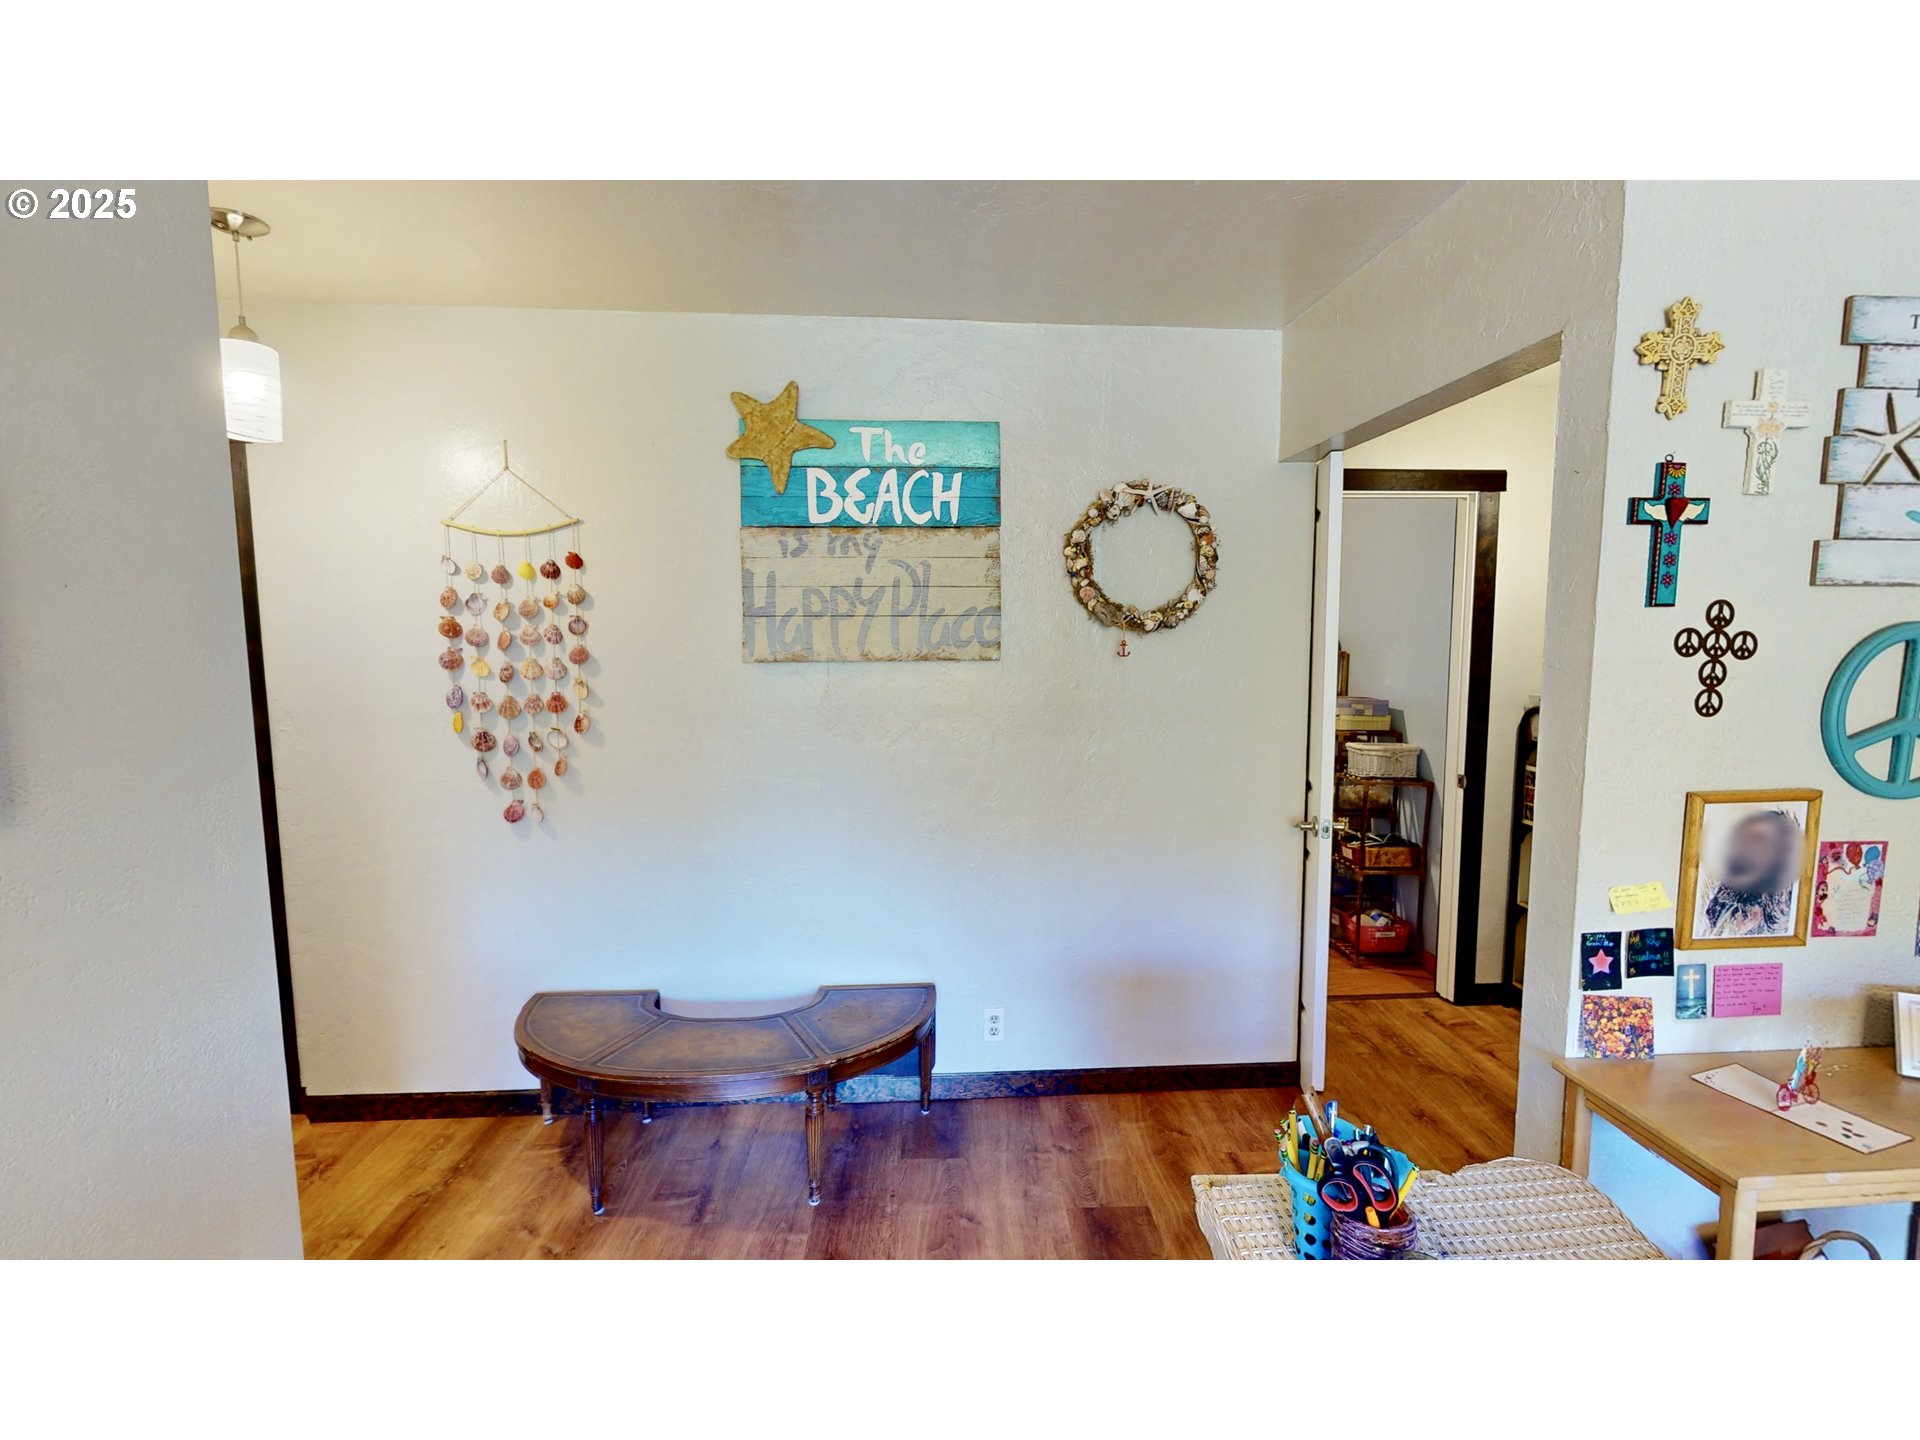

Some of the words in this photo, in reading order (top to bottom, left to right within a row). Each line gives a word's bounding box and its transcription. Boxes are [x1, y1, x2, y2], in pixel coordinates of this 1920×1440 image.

[849, 426, 927, 465] The
[806, 467, 963, 525] BEACH
[778, 529, 810, 559] is
[826, 529, 883, 575] my
[743, 568, 887, 657] Happy
[888, 559, 1001, 655] Place
